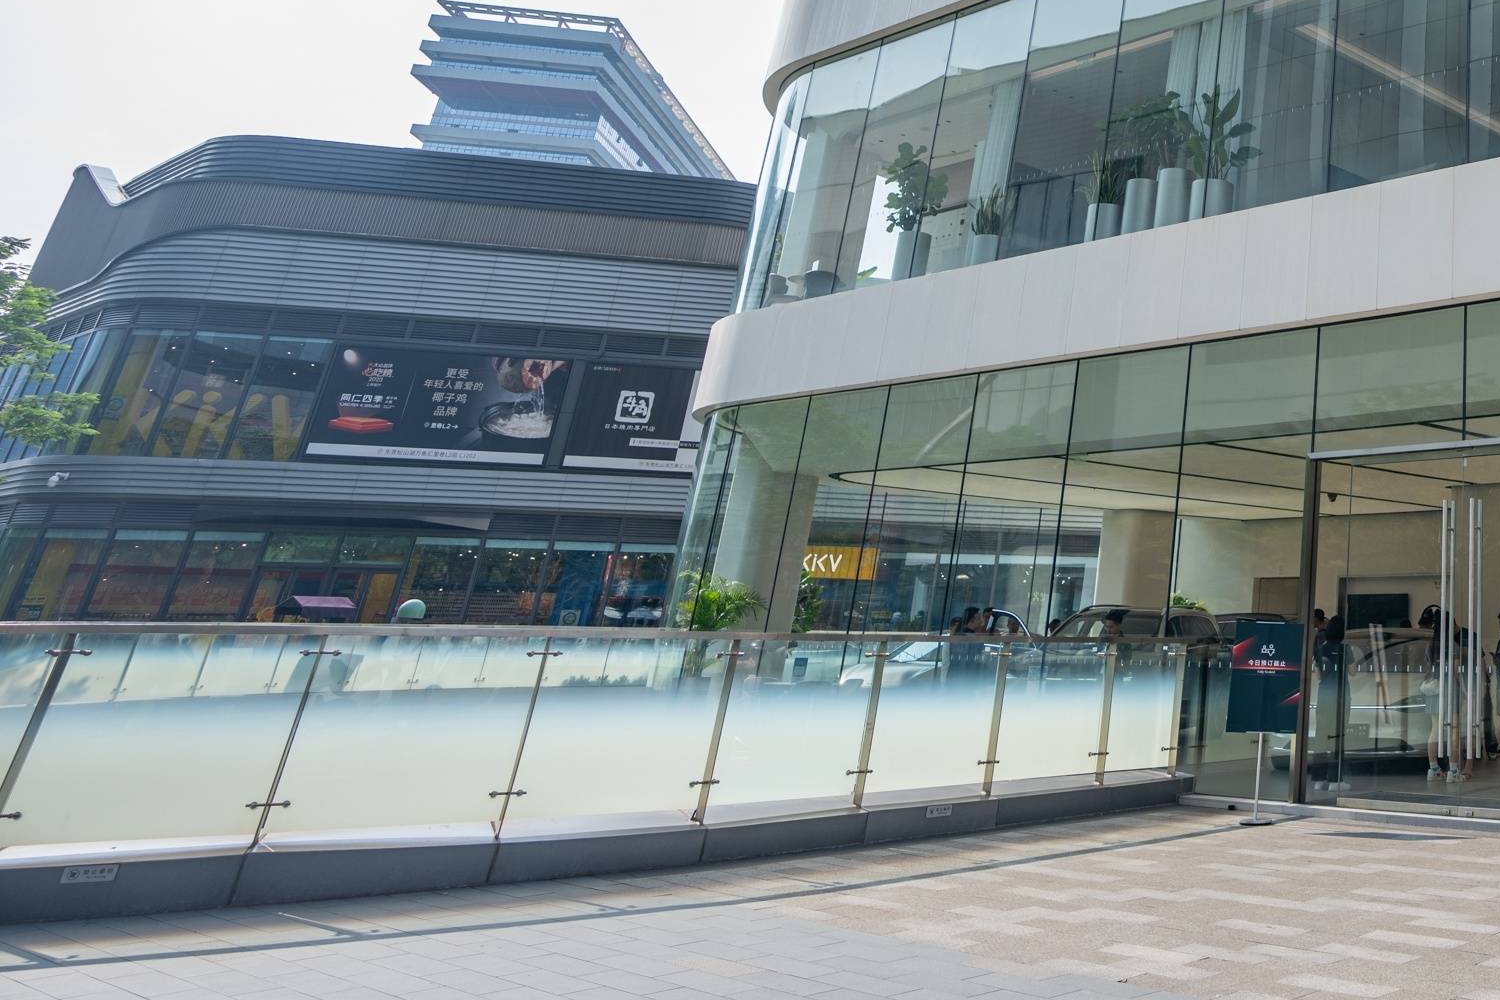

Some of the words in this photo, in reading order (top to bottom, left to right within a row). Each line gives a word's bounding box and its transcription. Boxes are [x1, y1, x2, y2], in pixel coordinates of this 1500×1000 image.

[445, 368, 469, 378] 更受
[424, 379, 483, 391] 年轻人喜爱的
[432, 392, 467, 403] 椰子鸡
[433, 406, 458, 416] 品牌
[622, 396, 648, 416] 牛角
